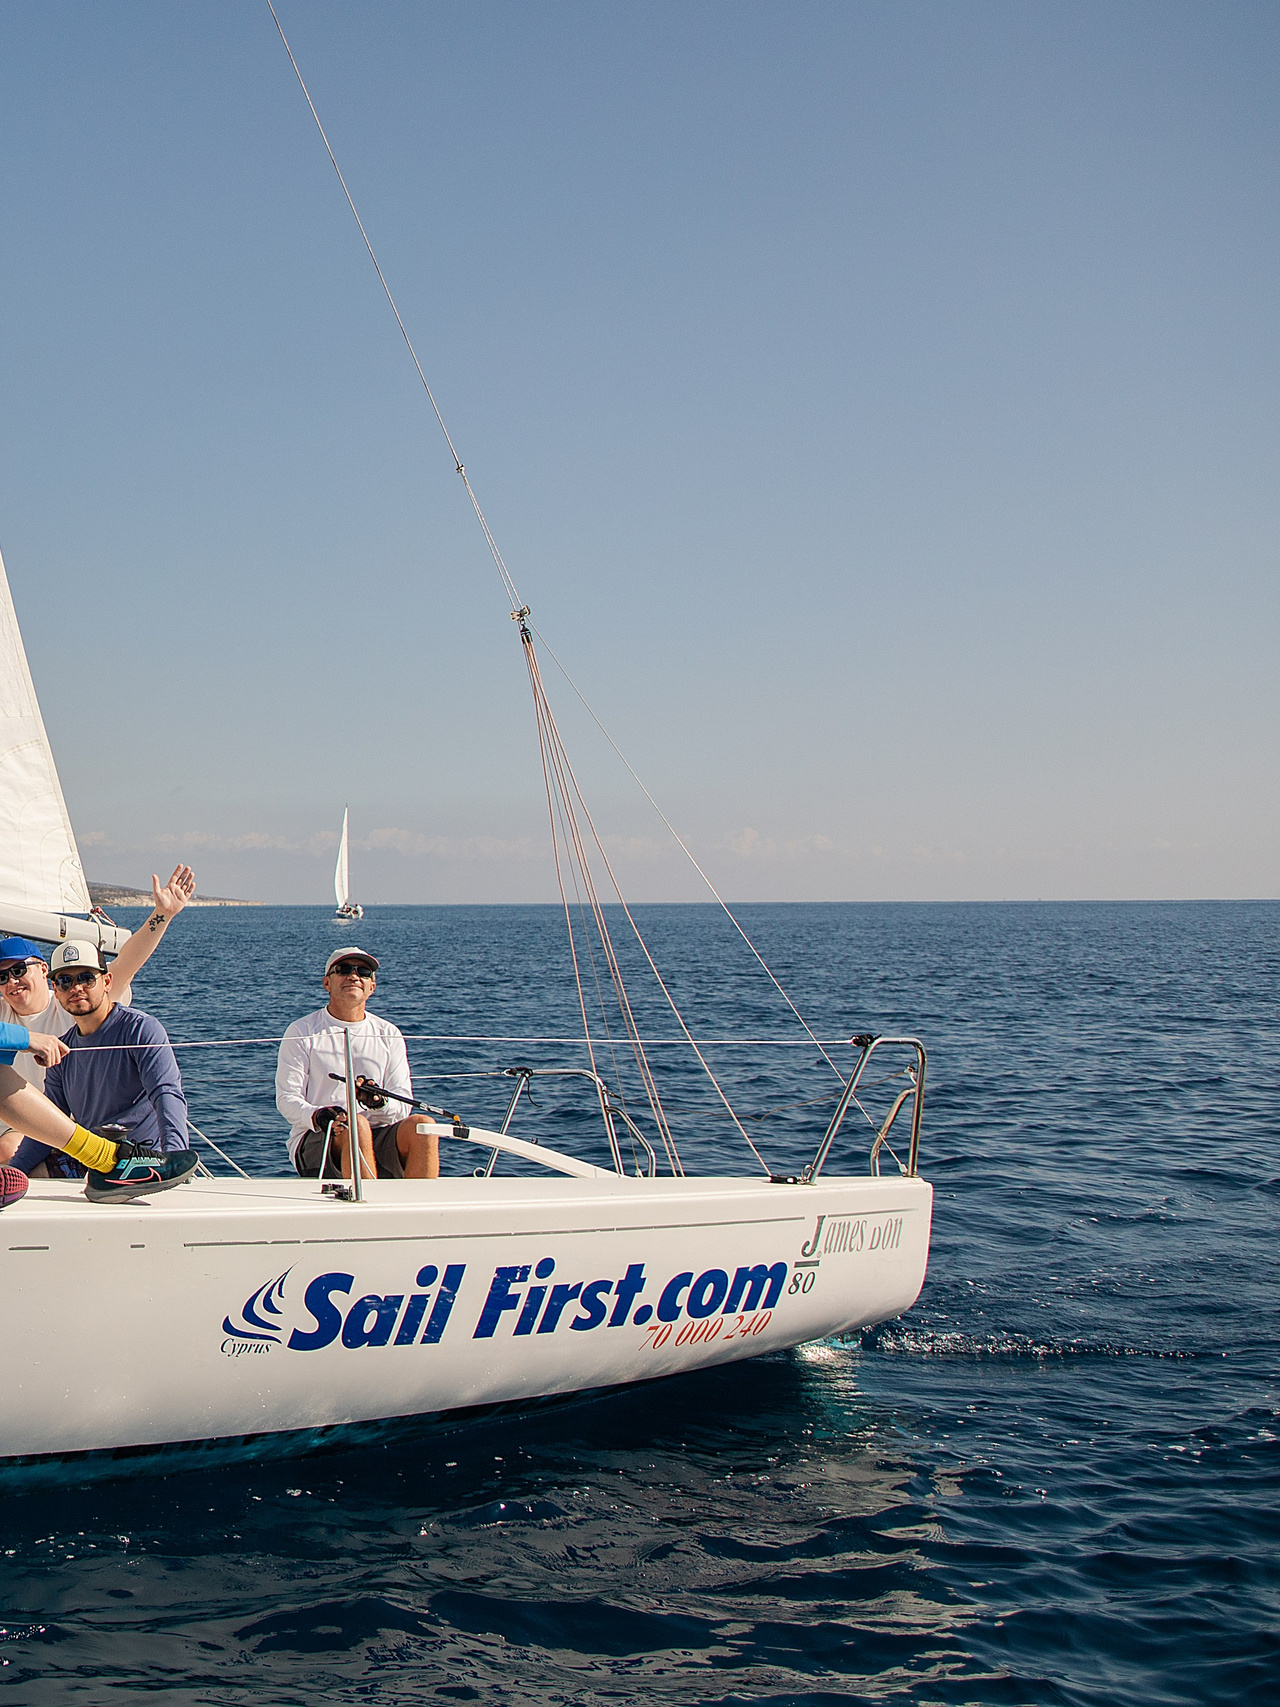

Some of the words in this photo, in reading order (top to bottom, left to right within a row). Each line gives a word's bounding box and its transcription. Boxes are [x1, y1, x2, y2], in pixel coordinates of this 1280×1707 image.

[801, 1215, 867, 1257] James
[788, 1271, 816, 1295] 80
[287, 1264, 467, 1351] Sail
[472, 1257, 788, 1339] First.com
[220, 1338, 272, 1358] Cyprus
[638, 1323, 673, 1351] 70
[674, 1317, 724, 1347] 000
[722, 1311, 772, 1340] 240
